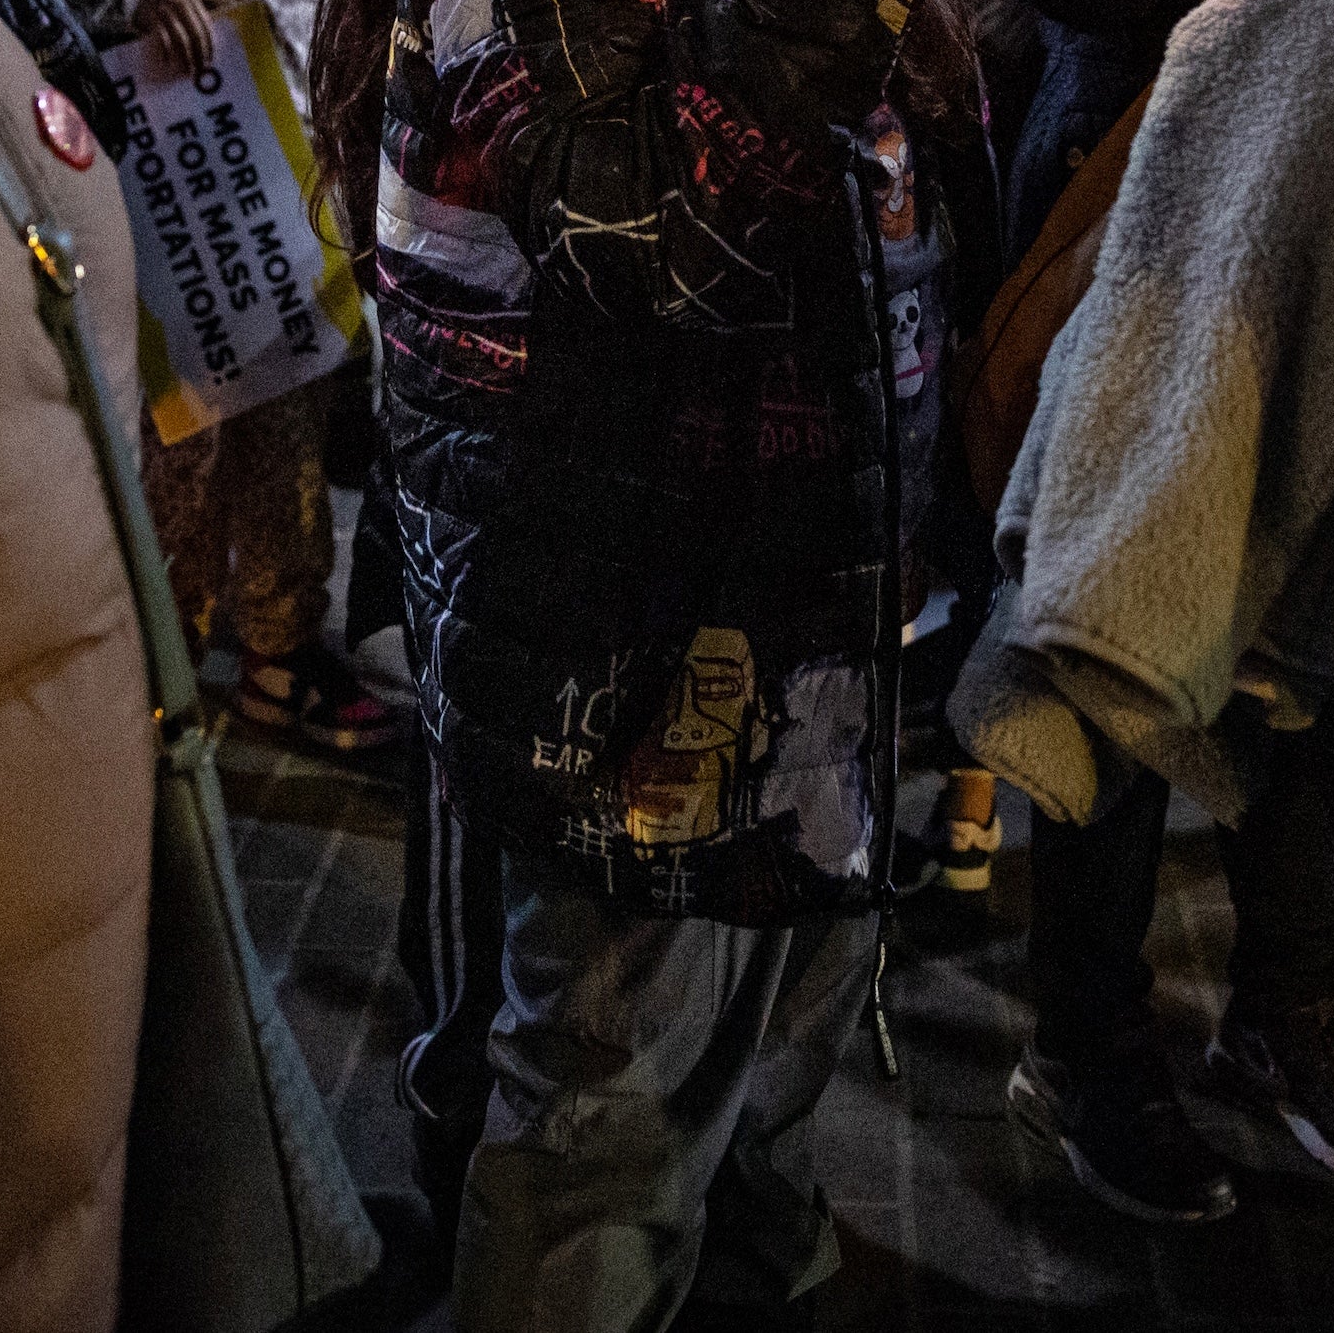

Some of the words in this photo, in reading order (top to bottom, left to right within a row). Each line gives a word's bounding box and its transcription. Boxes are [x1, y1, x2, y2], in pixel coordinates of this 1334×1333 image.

[195, 67, 222, 95] O
[168, 119, 216, 200] FOR
[200, 202, 259, 313] MASS
[207, 103, 267, 216] MORE
[114, 76, 241, 386] DEPORTATIONS!
[249, 220, 320, 357] MONEY
[531, 733, 594, 776] EAR
